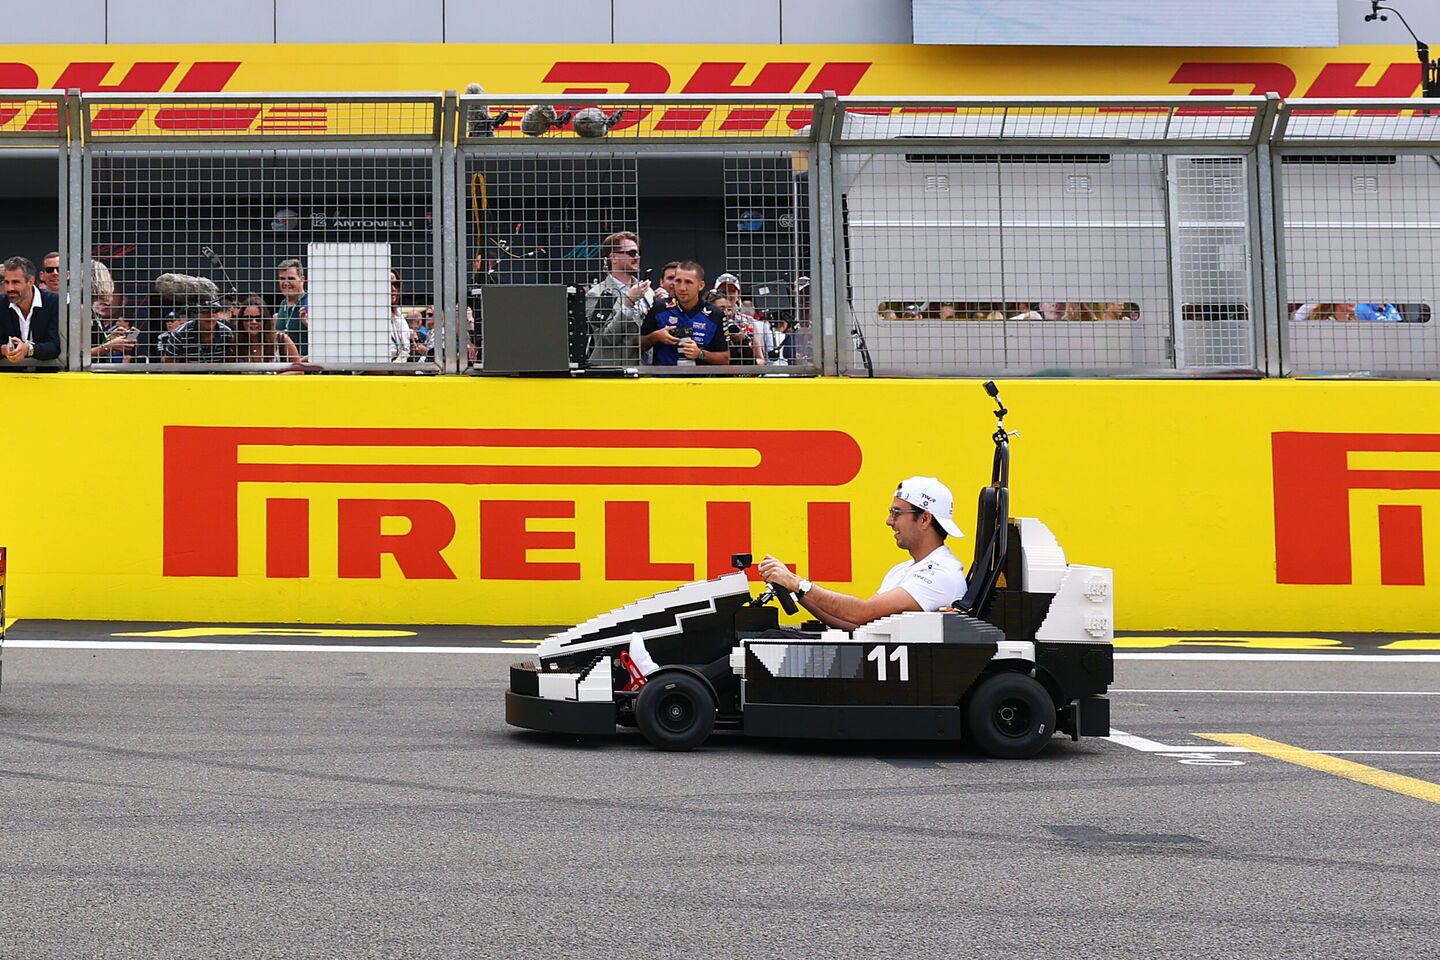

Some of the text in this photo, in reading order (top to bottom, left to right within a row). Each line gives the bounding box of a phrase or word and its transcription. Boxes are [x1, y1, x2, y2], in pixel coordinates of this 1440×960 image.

[538, 61, 892, 132] DHL
[1168, 62, 1440, 116] DH
[333, 219, 413, 227] ANTONELLI
[162, 425, 863, 583] PIRELLI
[867, 645, 909, 681] 11
